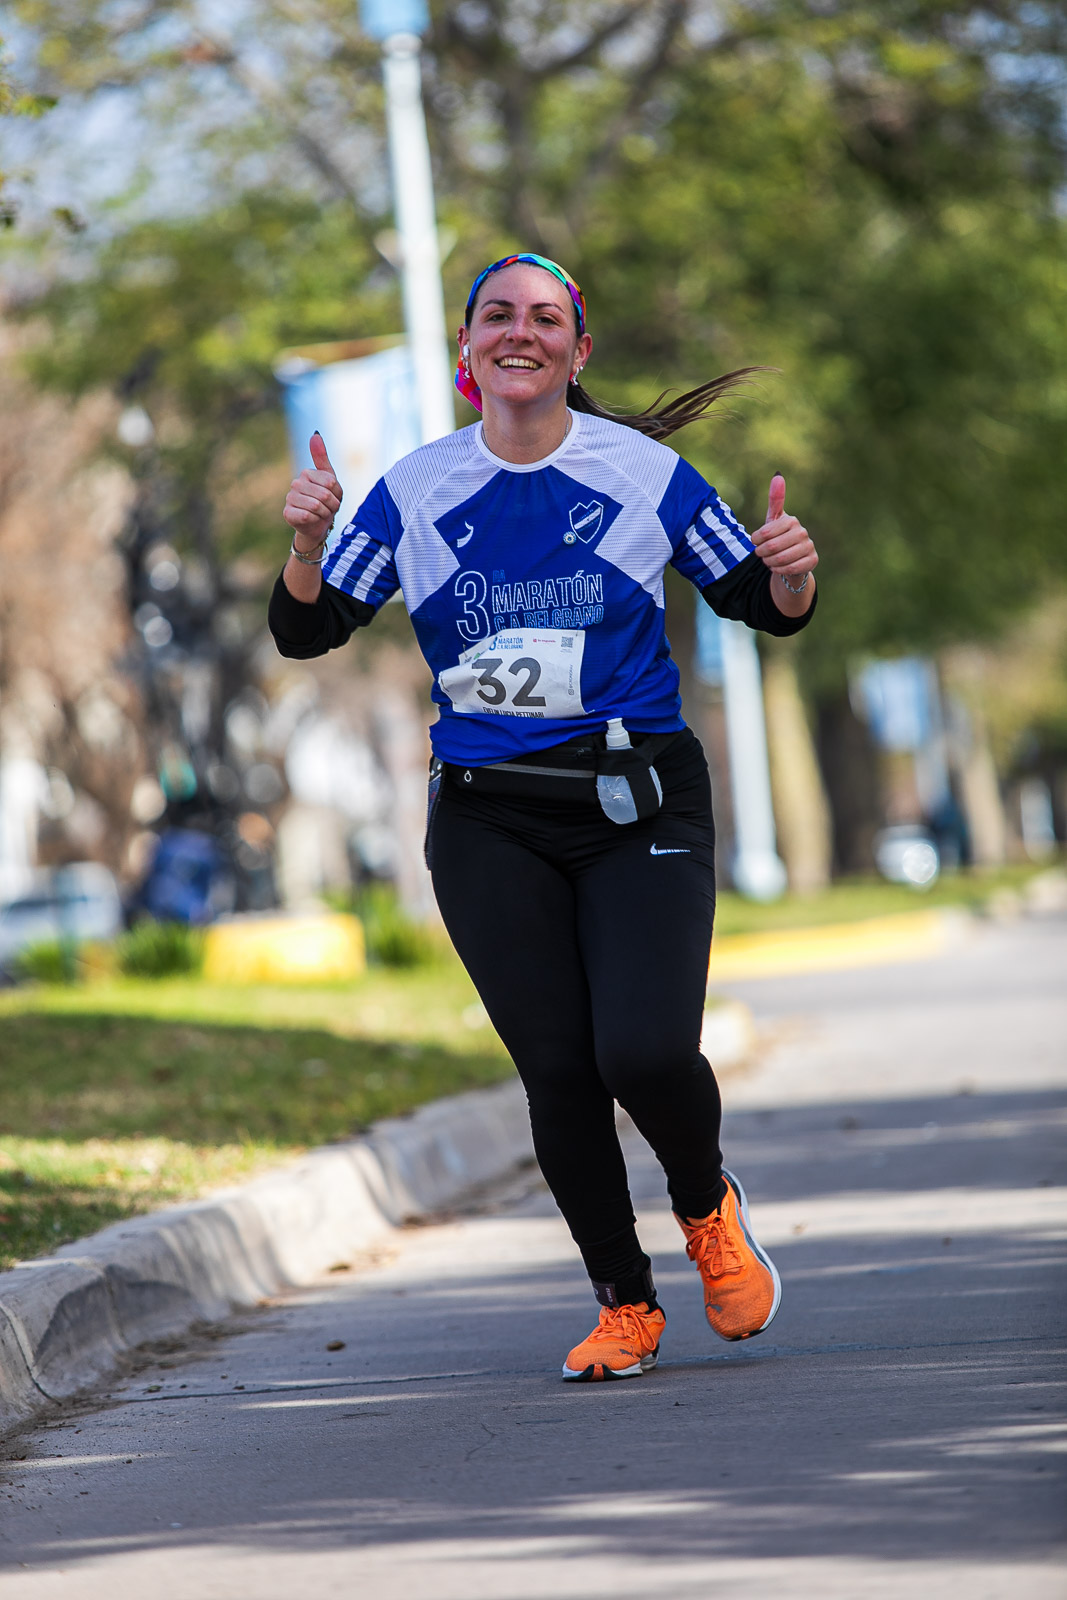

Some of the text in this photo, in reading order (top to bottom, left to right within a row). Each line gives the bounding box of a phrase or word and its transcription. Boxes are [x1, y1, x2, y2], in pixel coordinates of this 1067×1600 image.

[454, 570, 491, 642] 3
[491, 569, 604, 614] MARATÓN
[524, 604, 605, 629] BELGRANO
[471, 656, 547, 707] 32
